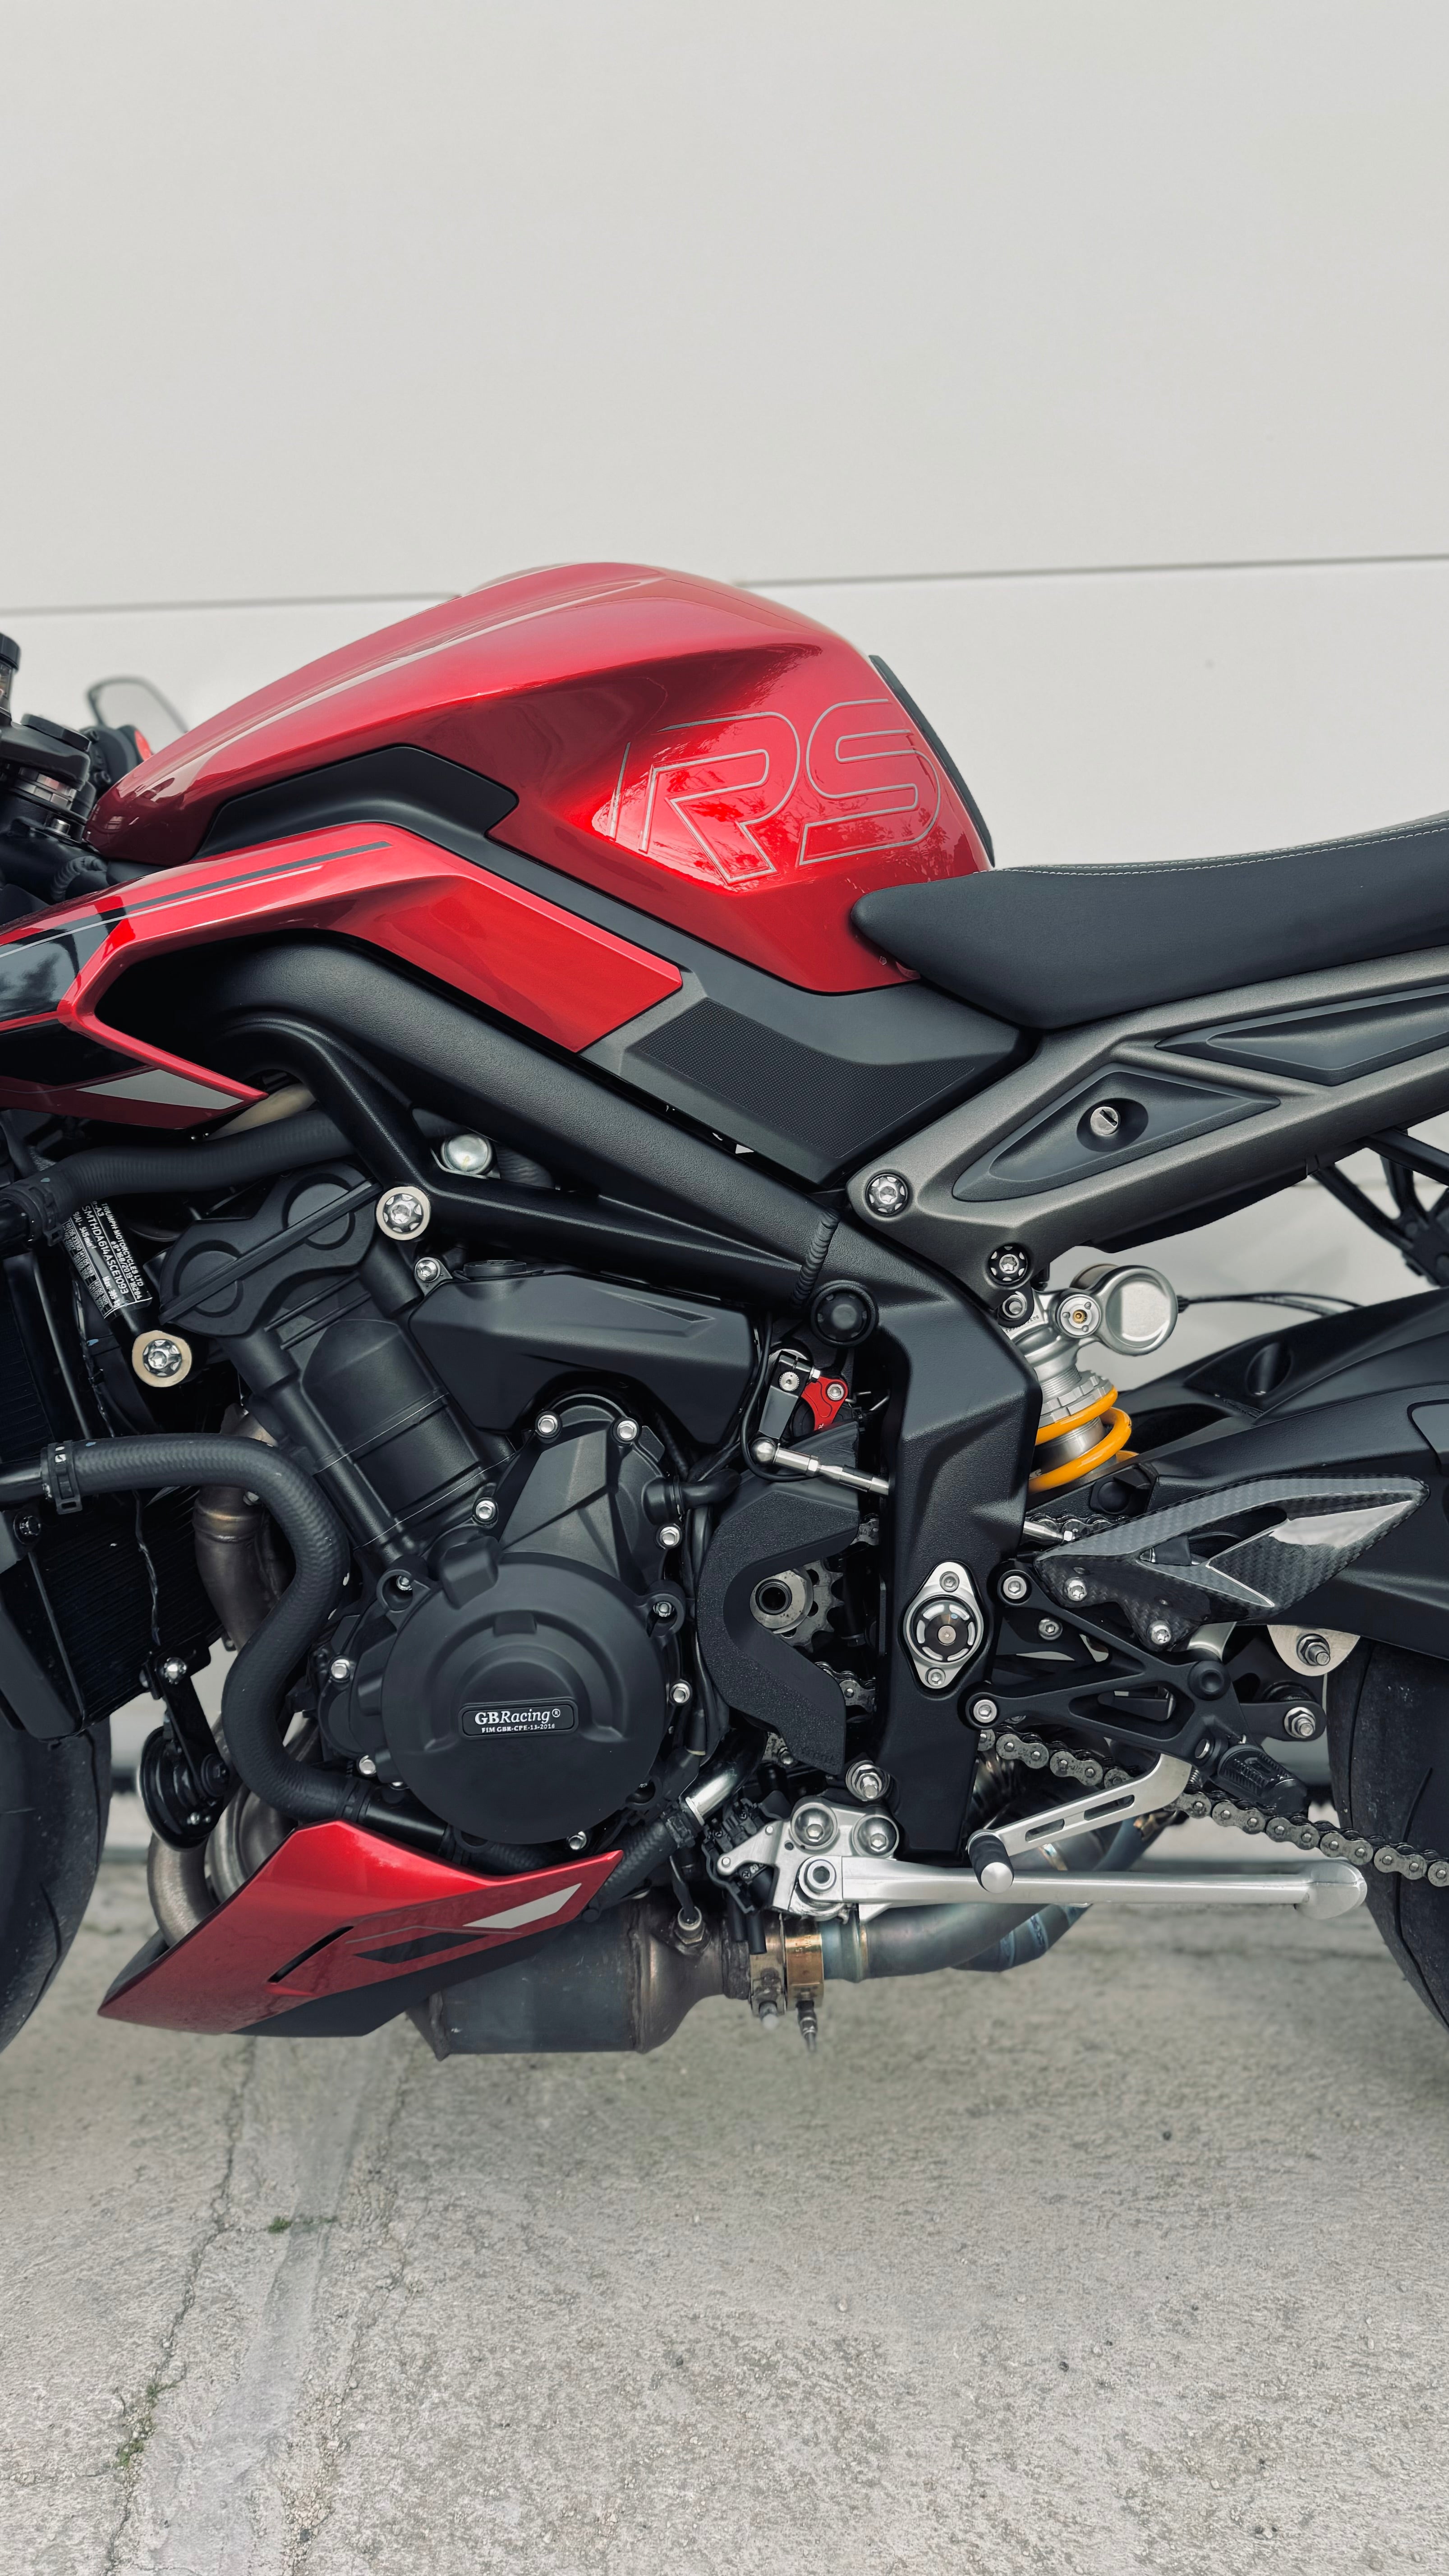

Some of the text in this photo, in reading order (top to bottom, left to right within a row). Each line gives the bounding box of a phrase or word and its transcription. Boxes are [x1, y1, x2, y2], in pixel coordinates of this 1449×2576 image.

[610, 699, 940, 885] RS
[101, 1203, 144, 1287] TRIUMPH MOTORCYCLES LTD
[113, 1299, 121, 1308] kg
